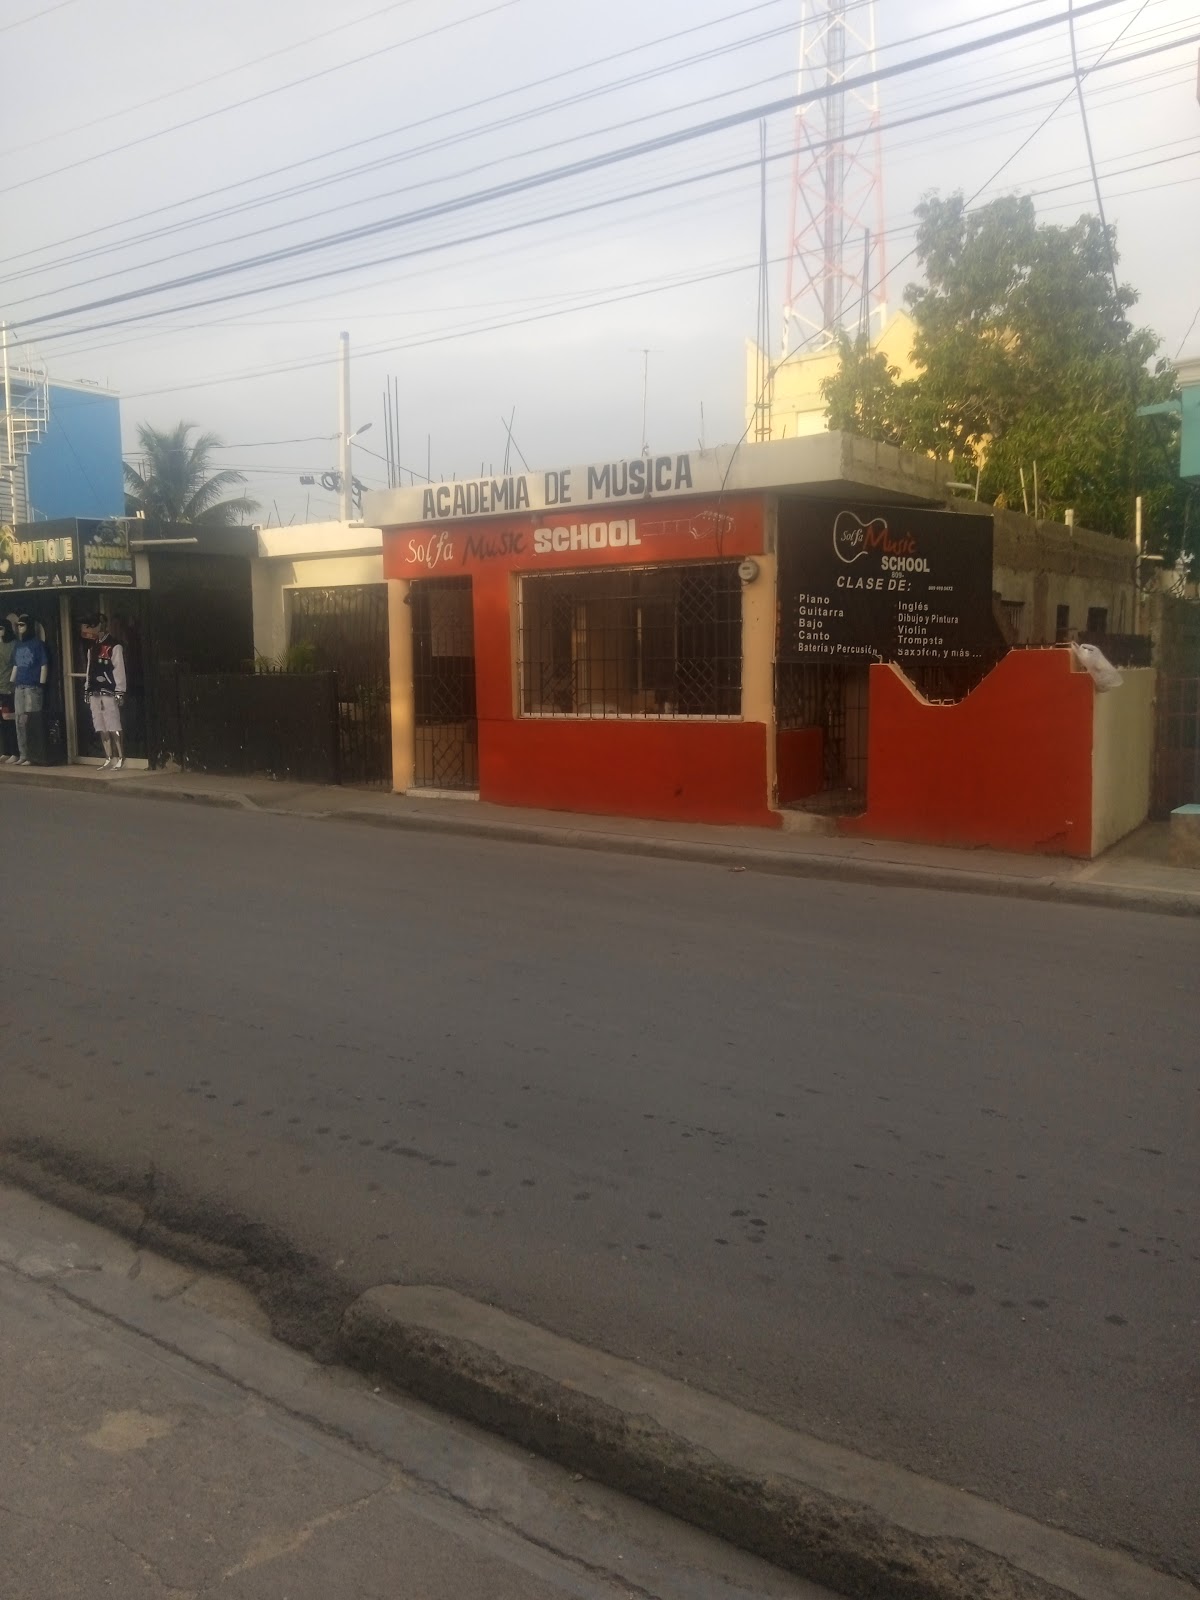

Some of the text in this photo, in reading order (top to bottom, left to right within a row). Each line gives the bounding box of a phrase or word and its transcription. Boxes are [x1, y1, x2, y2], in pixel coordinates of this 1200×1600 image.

[422, 454, 693, 520] ACADEMIA DE MÚSICA
[405, 530, 454, 569] Solfa
[533, 518, 642, 554] SCHOOL
[840, 525, 918, 555] Solfa Music
[12, 537, 73, 566] BOUTIQUE
[881, 555, 931, 573] SCHOOL
[836, 575, 884, 591] CLASE
[887, 578, 912, 592] DE:
[799, 593, 830, 605] Piano
[798, 605, 844, 617] Guitarra
[898, 600, 929, 613] Inglés
[798, 618, 823, 630] Bajo
[898, 613, 959, 625] Dibujo y Pintura
[798, 630, 830, 641] Canto
[897, 635, 944, 647] Trompeta
[830, 645, 836, 655] y
[943, 649, 949, 659] y
